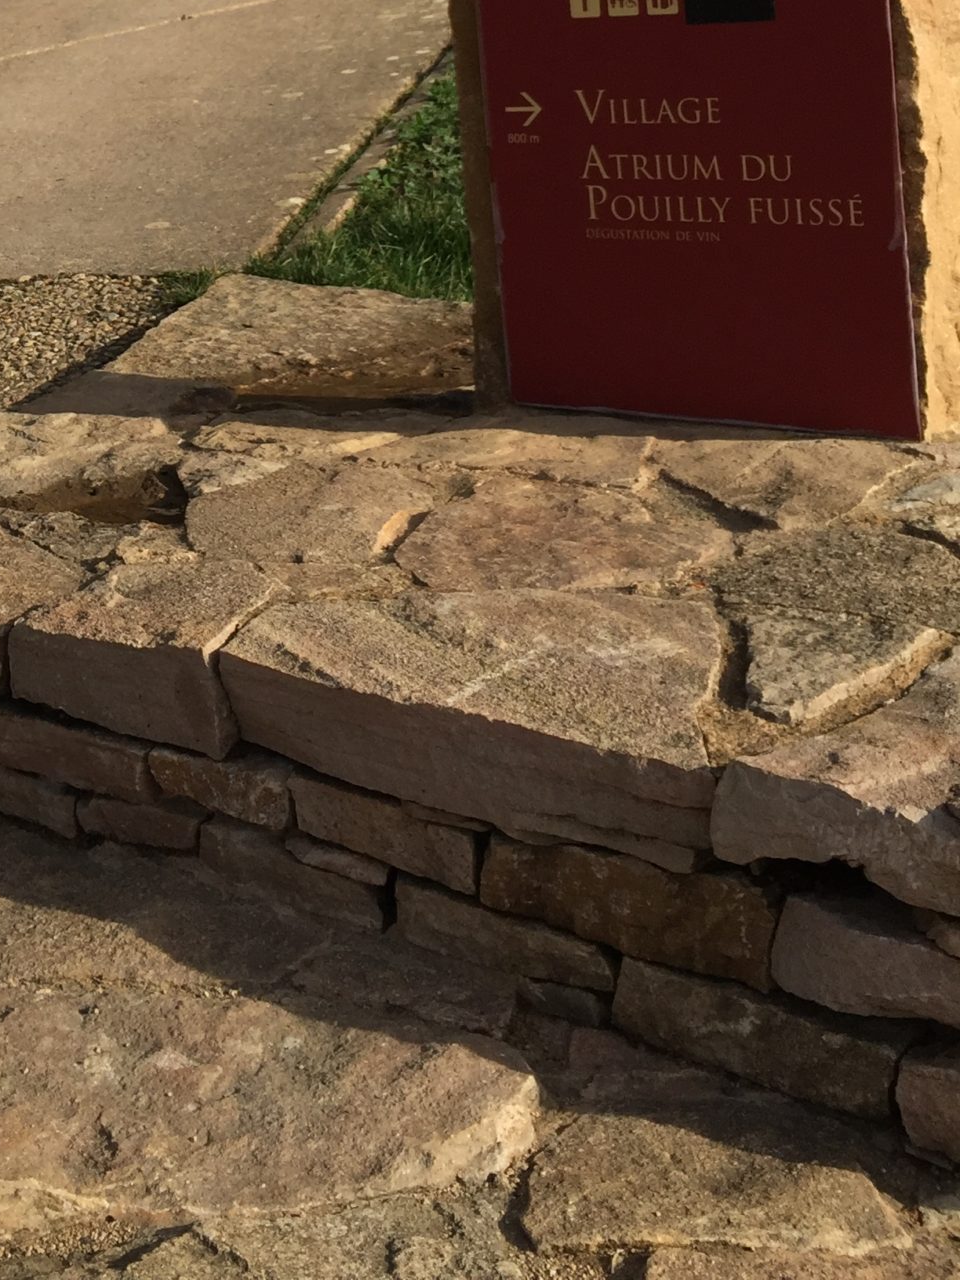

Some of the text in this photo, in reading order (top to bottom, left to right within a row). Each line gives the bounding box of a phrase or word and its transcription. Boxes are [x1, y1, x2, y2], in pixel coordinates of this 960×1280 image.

[574, 88, 721, 125] VILLAGE
[529, 134, 539, 143] m
[580, 145, 793, 181] ATRIUM DU
[585, 185, 865, 227] POUILLY FUISSÉ
[675, 231, 693, 241] DE
[697, 232, 721, 242] VIN
